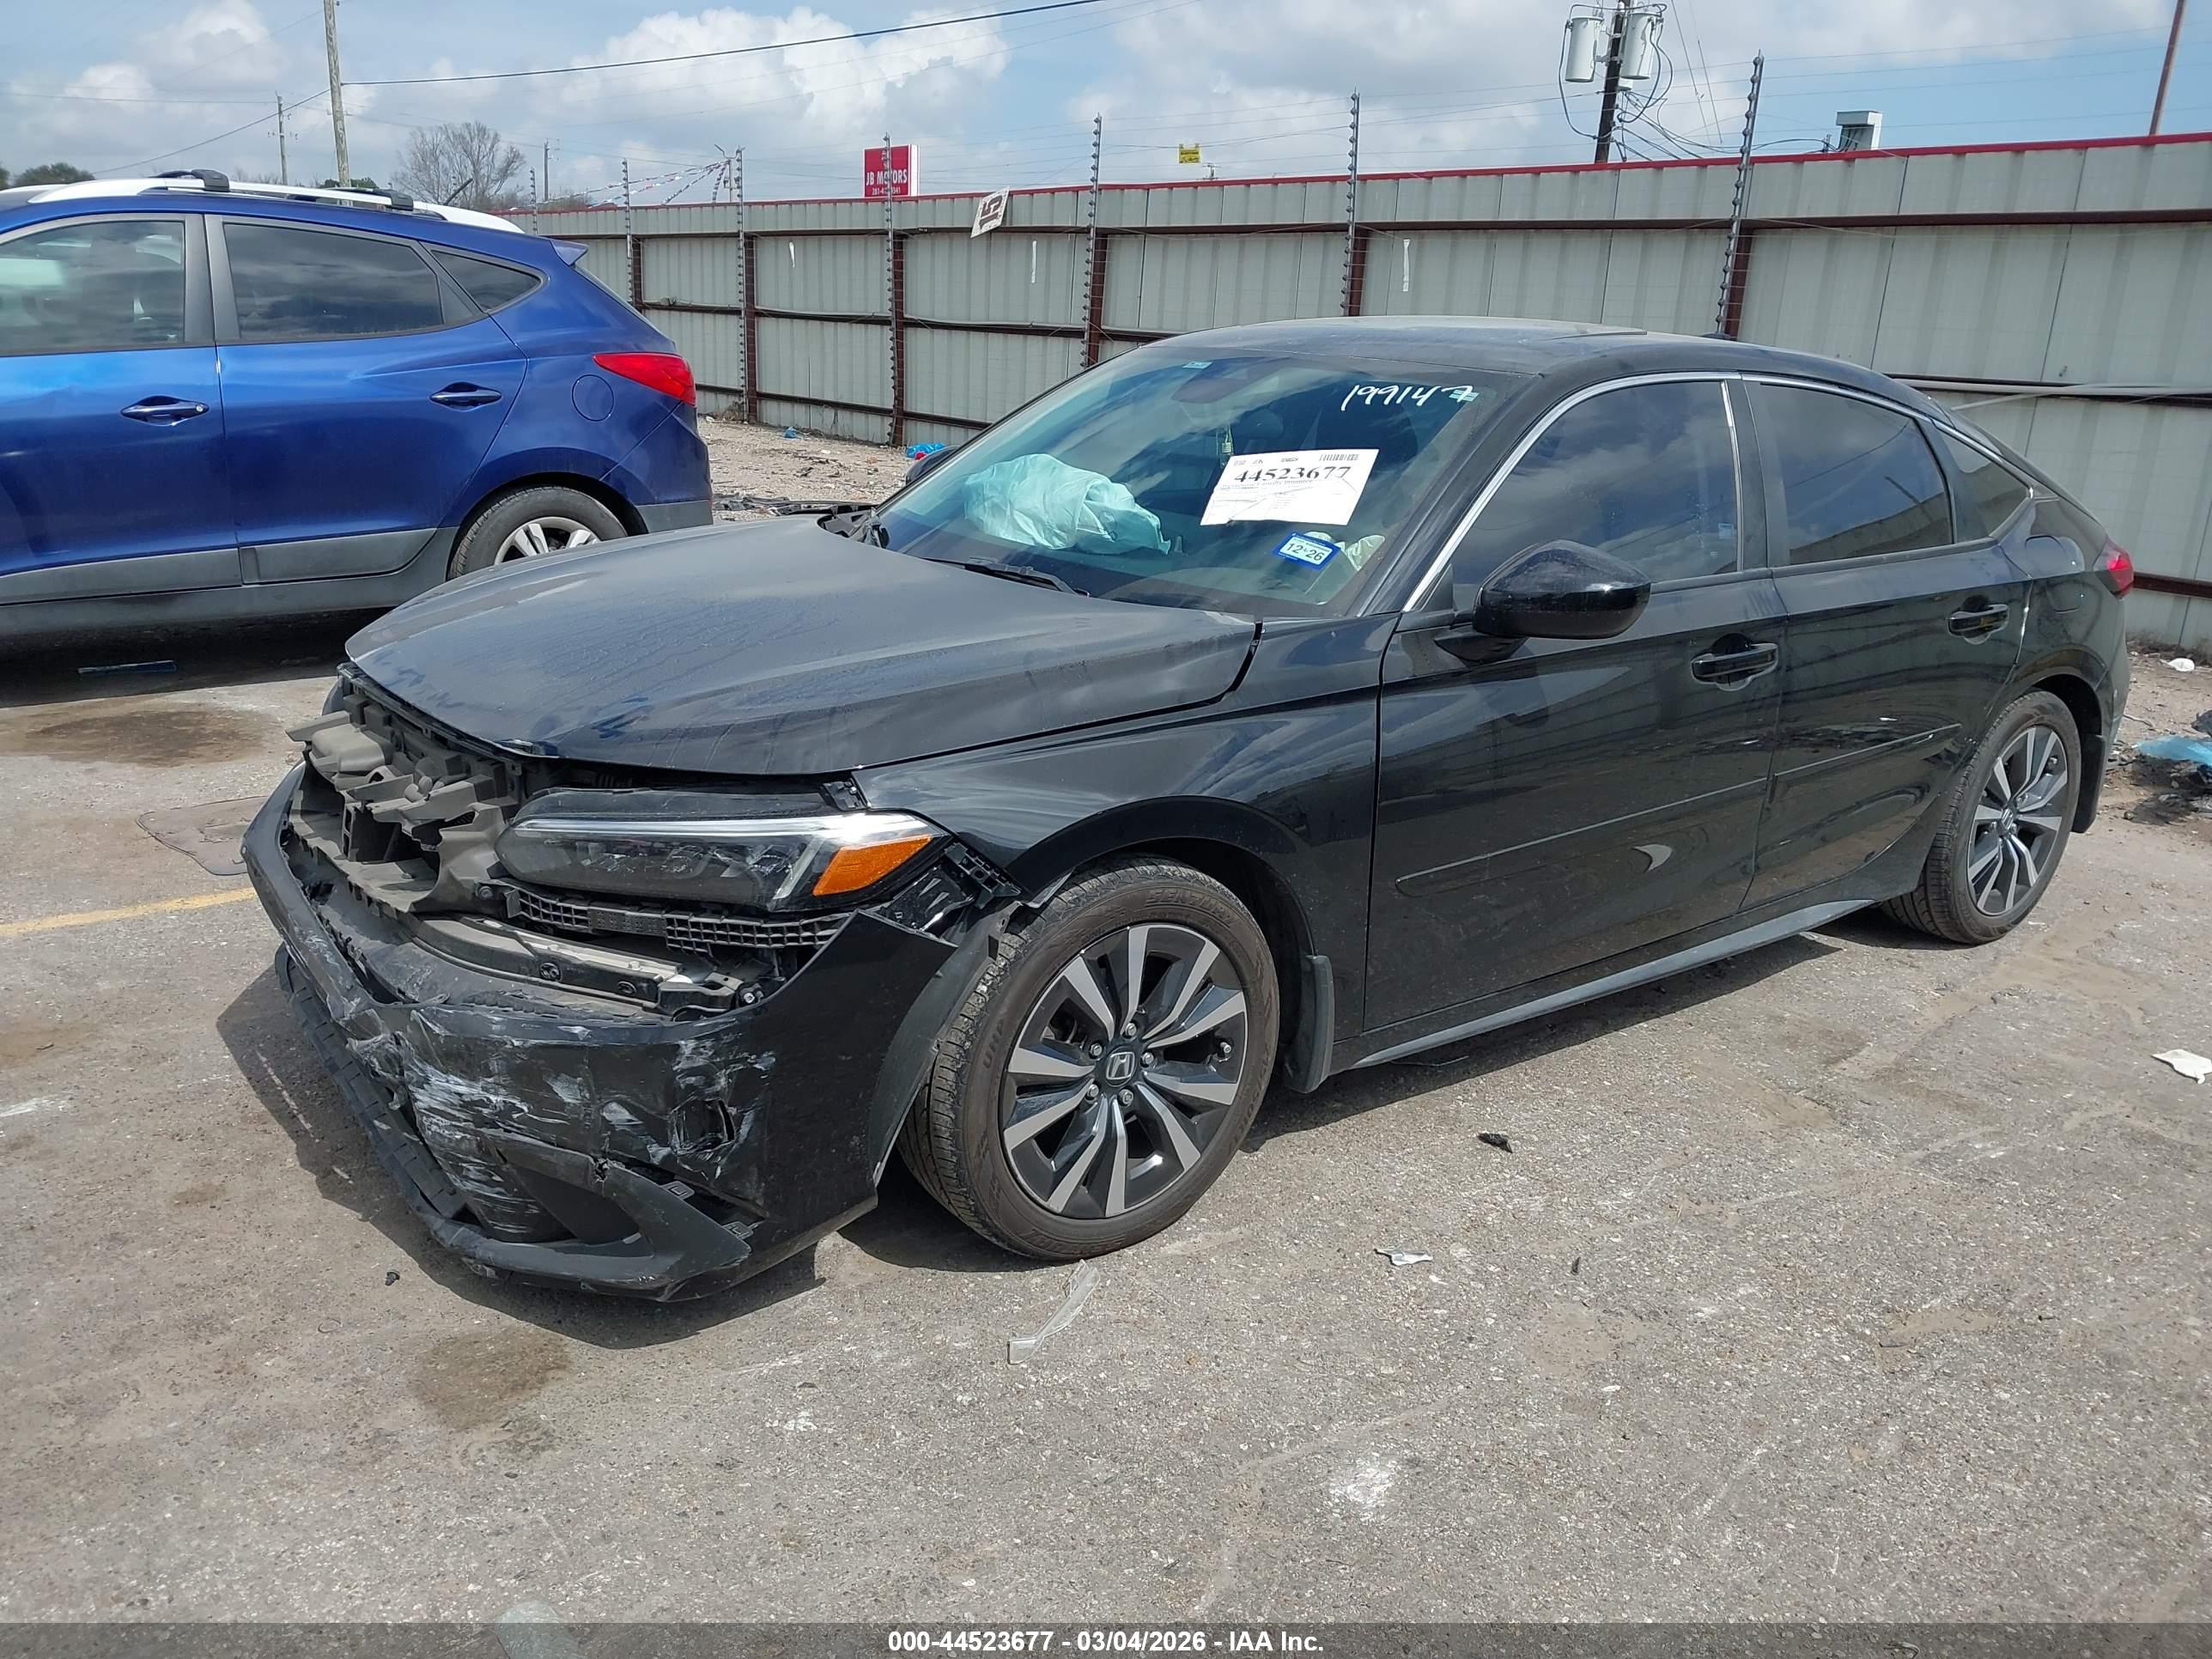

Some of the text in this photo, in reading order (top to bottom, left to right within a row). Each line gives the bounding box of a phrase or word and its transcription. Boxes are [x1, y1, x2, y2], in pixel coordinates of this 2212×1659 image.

[866, 171, 875, 185] JB
[979, 195, 1003, 230] 15
[1234, 465, 1351, 483] 44523677
